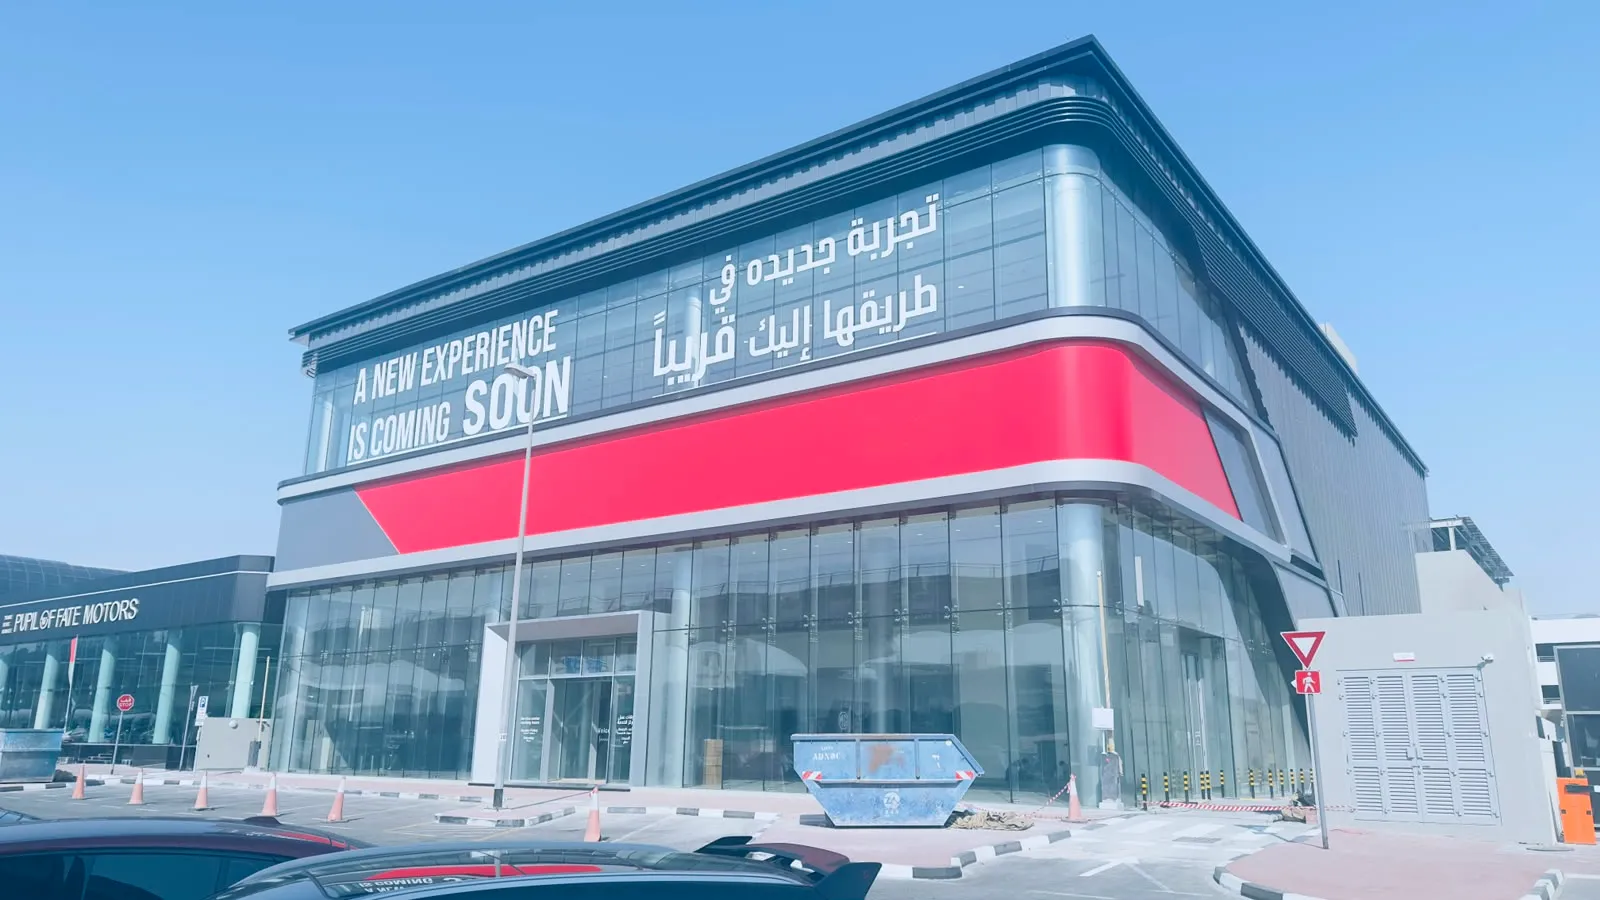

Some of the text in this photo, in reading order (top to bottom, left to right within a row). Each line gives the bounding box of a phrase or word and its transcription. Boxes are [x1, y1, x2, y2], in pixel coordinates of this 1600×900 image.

[709, 193, 940, 314] تجربة جديده في
[748, 304, 812, 361] إليك
[823, 274, 937, 347] طريقها
[353, 309, 559, 405] A NEW EXPERIENCE
[347, 355, 571, 462] IS COMING SOON
[13, 611, 39, 633] PUPIL
[55, 606, 81, 628] FATE
[82, 598, 139, 625] MOTORS
